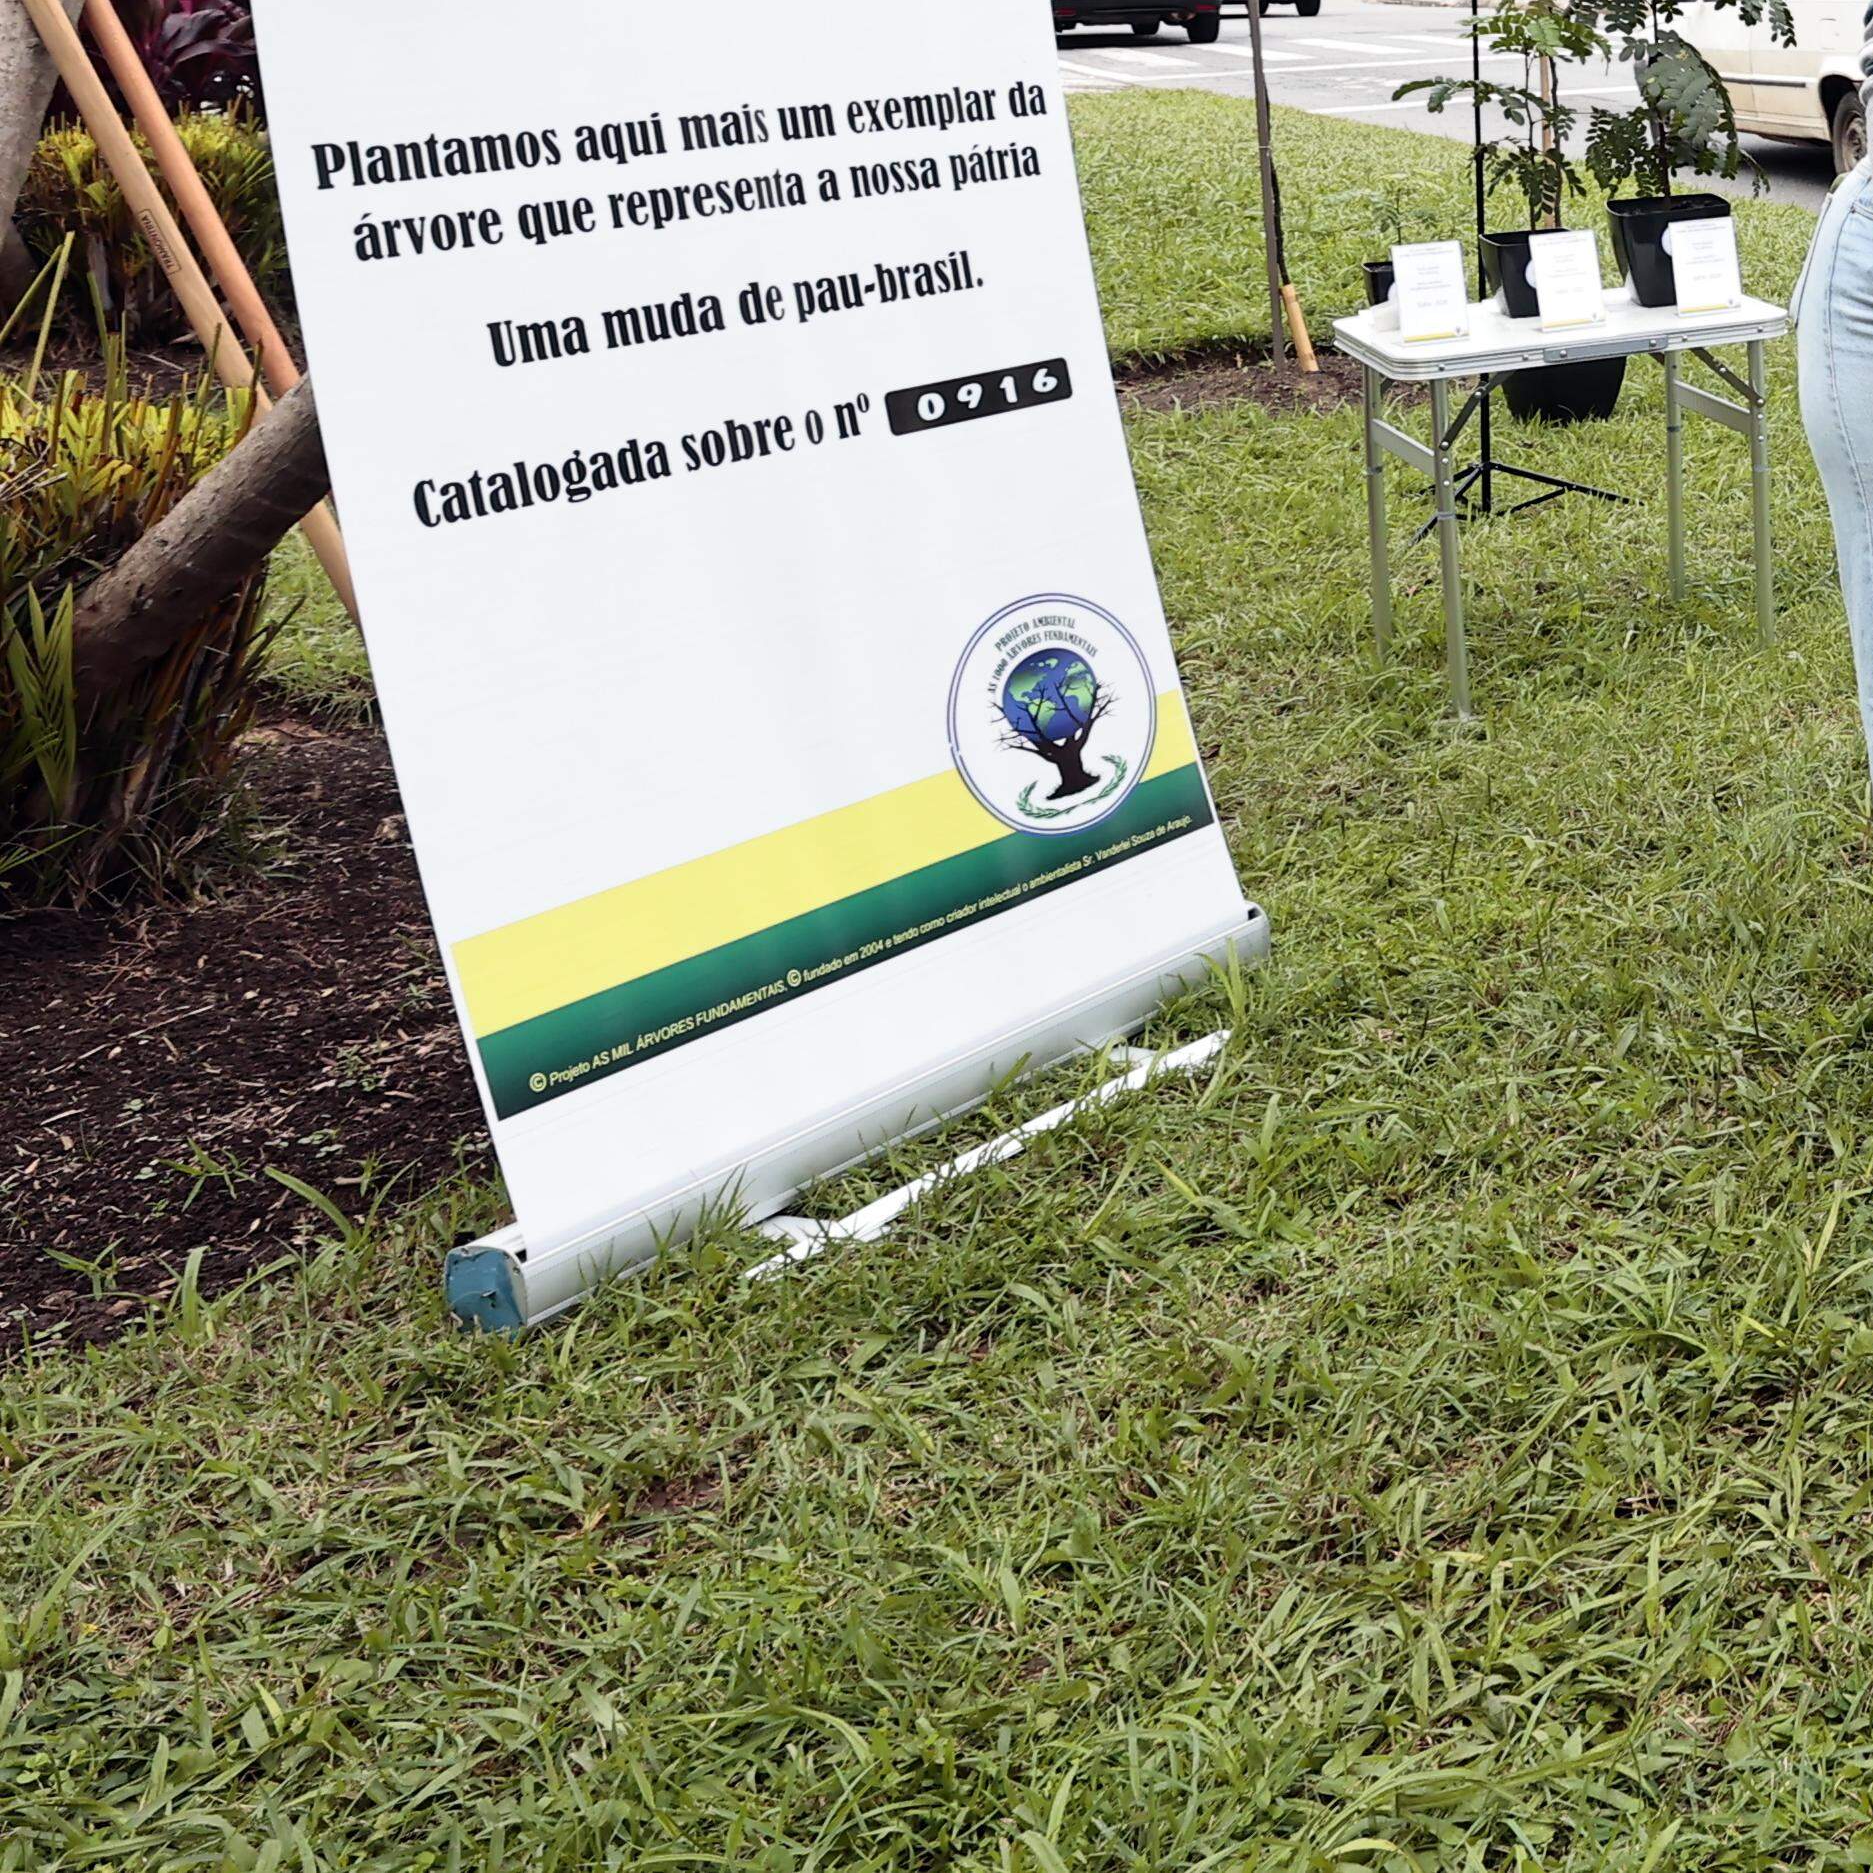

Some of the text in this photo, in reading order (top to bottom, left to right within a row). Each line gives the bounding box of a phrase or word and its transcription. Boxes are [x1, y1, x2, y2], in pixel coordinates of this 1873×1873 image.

[312, 82, 1046, 189] Plantamos aqui mais um exemplar da
[354, 147, 1040, 261] árvore que representa a nossa pátria
[487, 251, 983, 366] Uma muda de pau-brasil.
[414, 369, 1057, 527] Catalogada sobre o nº 0916
[992, 658, 1008, 680] 1000
[1044, 630, 1099, 658] FUNDAMENTAIS
[994, 615, 1076, 652] PROJETO AMBIENTAL
[549, 1061, 590, 1086] Projeto
[592, 1050, 610, 1069] AS
[611, 1042, 634, 1062] MIL
[636, 1017, 695, 1052] ÁRVORES
[803, 958, 842, 982] fundado
[844, 951, 859, 966] em
[860, 939, 884, 959] 2004
[885, 938, 892, 948] e
[893, 926, 919, 945] tendo
[919, 917, 944, 934] como
[946, 902, 977, 923] criador
[978, 884, 1022, 911] intelectual
[1022, 882, 1029, 892] o
[1030, 860, 1082, 890] ambientalista
[1083, 854, 1096, 868] Sr.
[1132, 829, 1155, 847] Souza
[1156, 824, 1166, 836] de
